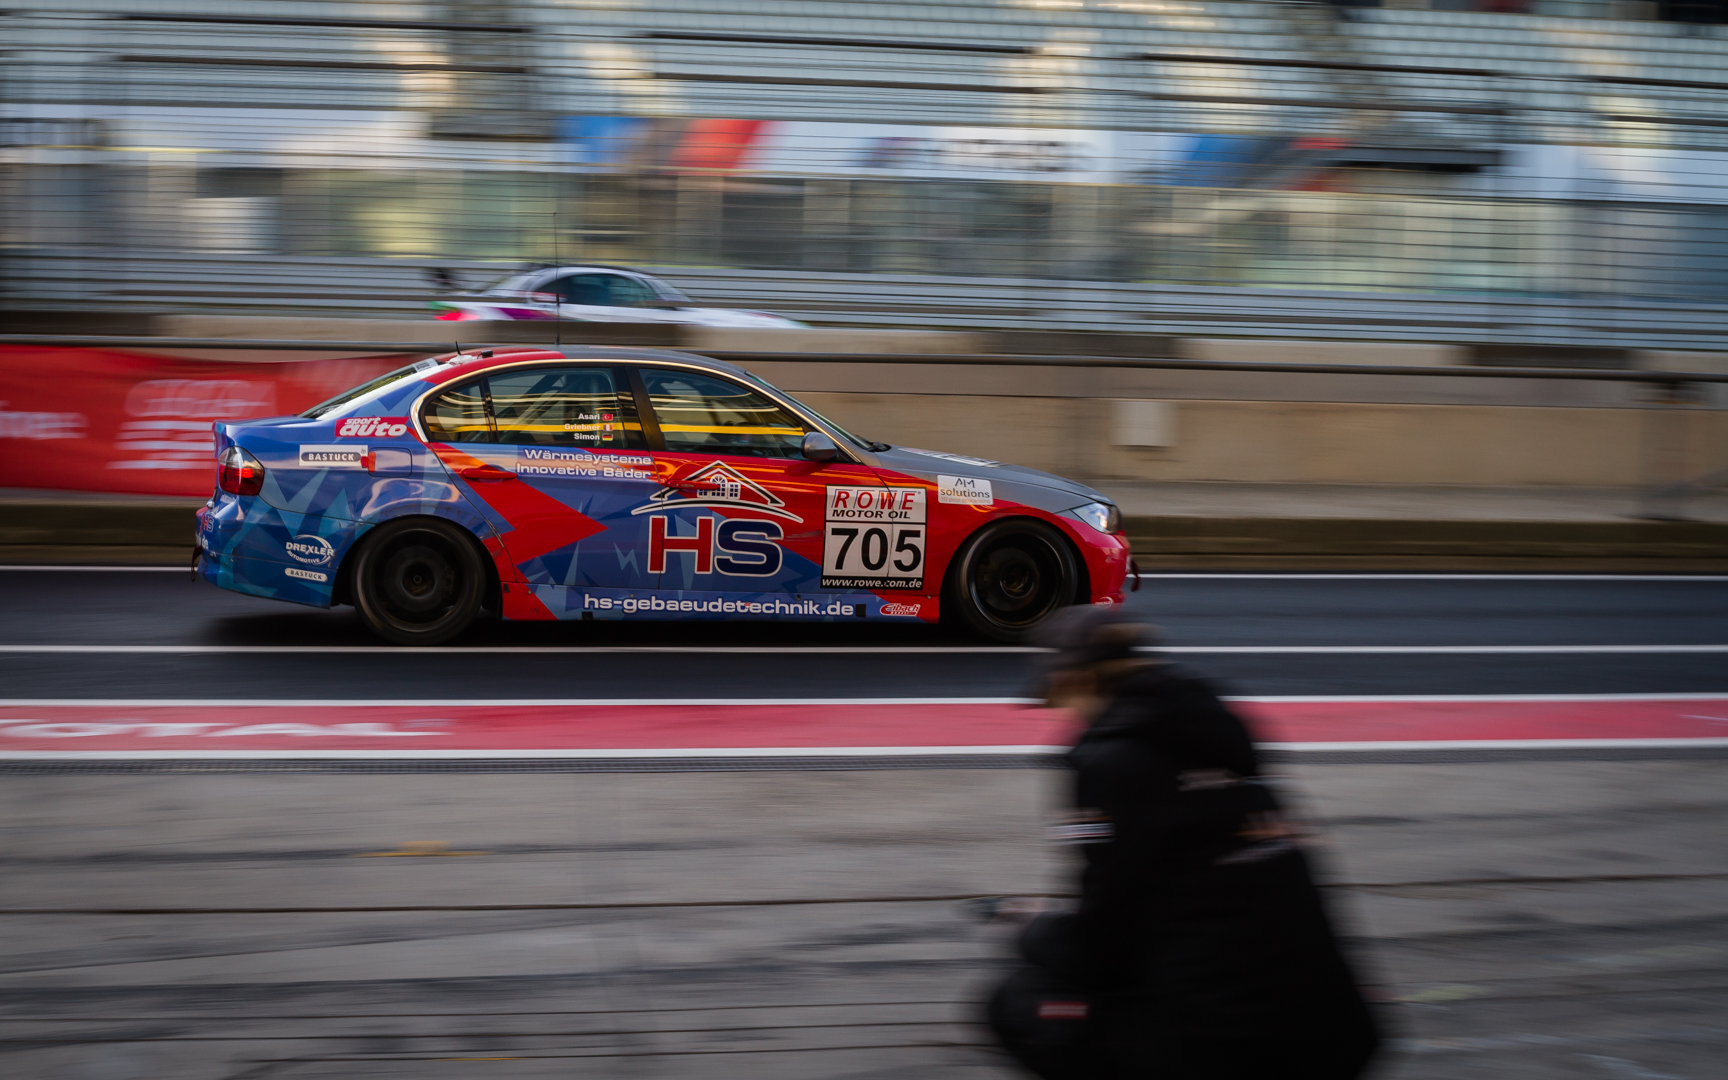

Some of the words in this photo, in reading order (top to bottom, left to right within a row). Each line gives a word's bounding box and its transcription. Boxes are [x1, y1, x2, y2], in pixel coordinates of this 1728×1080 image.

[344, 416, 381, 426] sport
[564, 423, 600, 431] Griebner
[339, 422, 407, 437] auto
[574, 432, 600, 440] Simon
[308, 453, 355, 461] BASTUCK
[524, 449, 652, 465] Wärmesysteme
[517, 463, 597, 477] Innovative
[603, 467, 652, 479] Bäder
[831, 489, 916, 510] ROWE
[940, 487, 990, 498] solutions
[832, 509, 883, 519] MOTOR
[888, 511, 911, 519] OIL
[285, 541, 335, 557] DREXLER
[647, 515, 784, 577] HS
[831, 527, 922, 572] 705
[287, 550, 320, 564] AUTOMOTIVE
[290, 569, 323, 580] BASTUCK
[821, 578, 923, 588] www.rowe.com.de
[584, 593, 854, 616] hs-gebaeudetechnik.de
